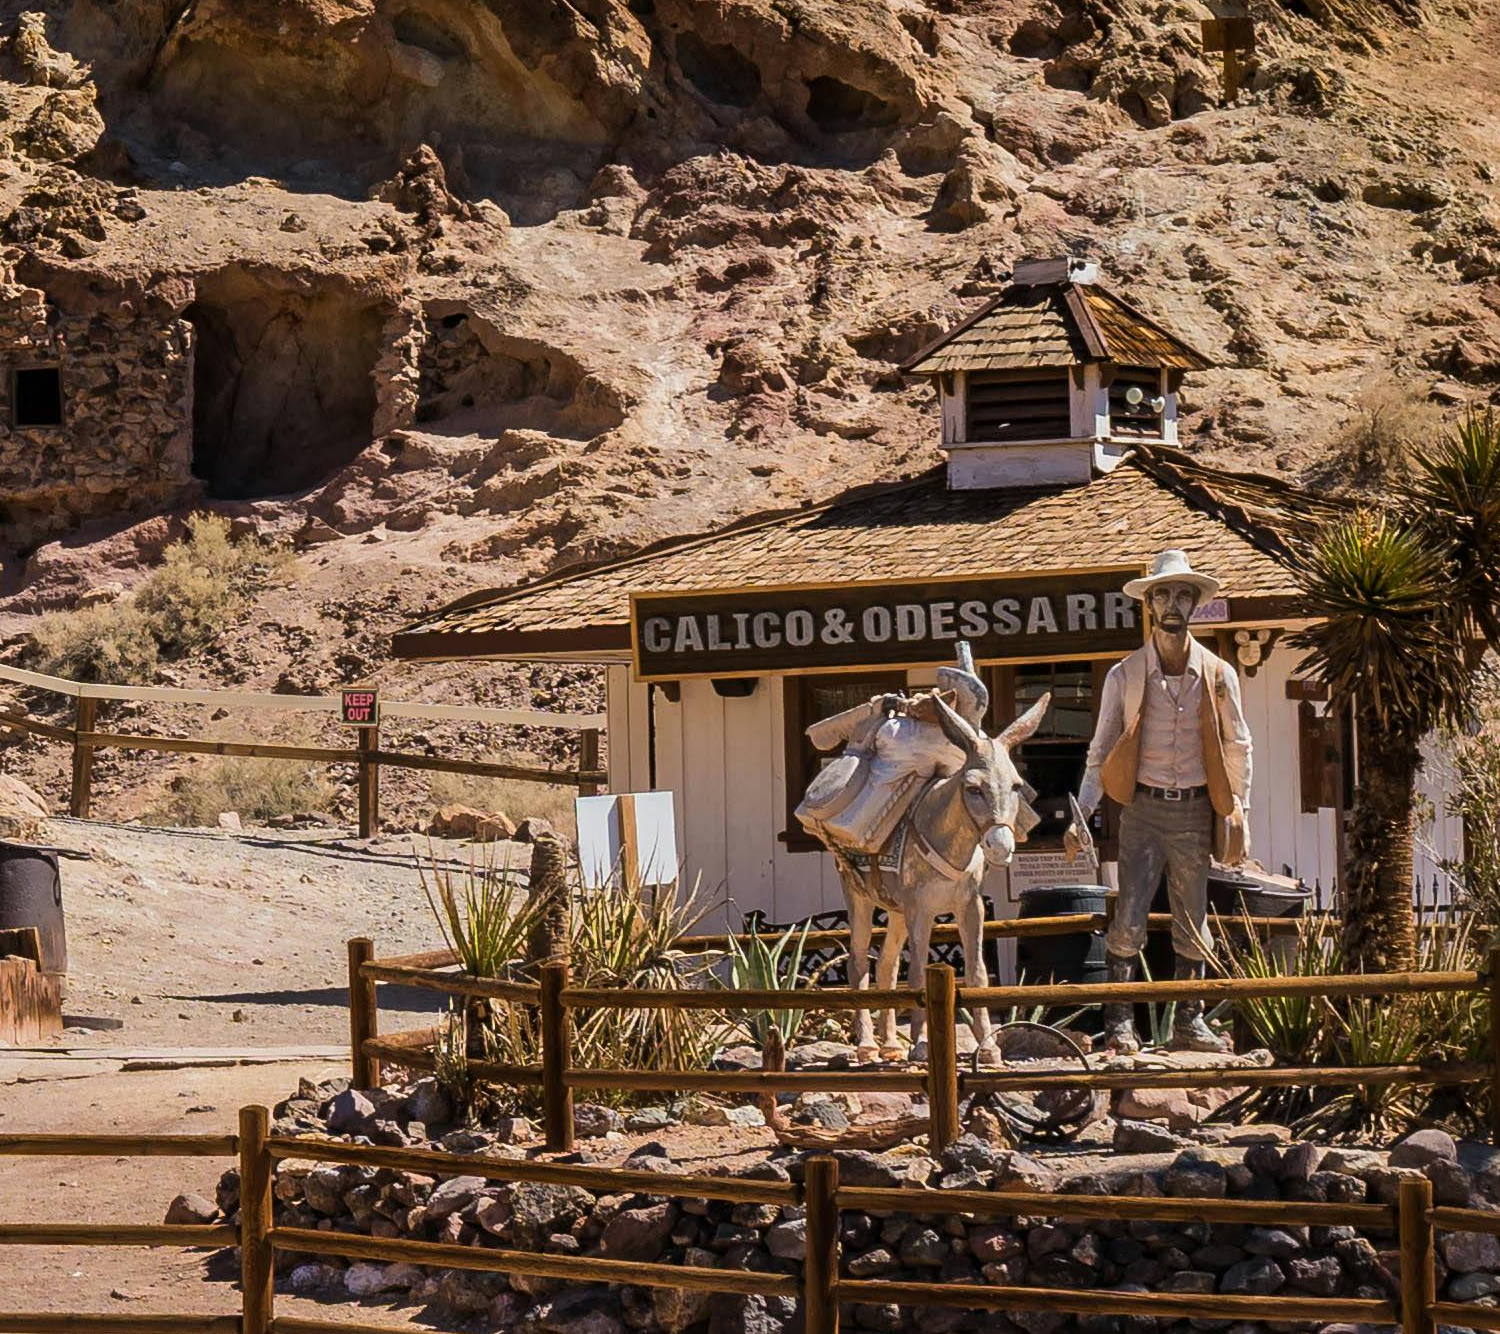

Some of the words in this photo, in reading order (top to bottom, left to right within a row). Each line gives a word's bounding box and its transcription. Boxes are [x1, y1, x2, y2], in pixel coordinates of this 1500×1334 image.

[643, 610, 815, 654] CALICO
[820, 607, 855, 645] &
[863, 595, 1060, 643] ODESSA
[344, 693, 374, 706] KEEP
[347, 708, 371, 721] OUT
